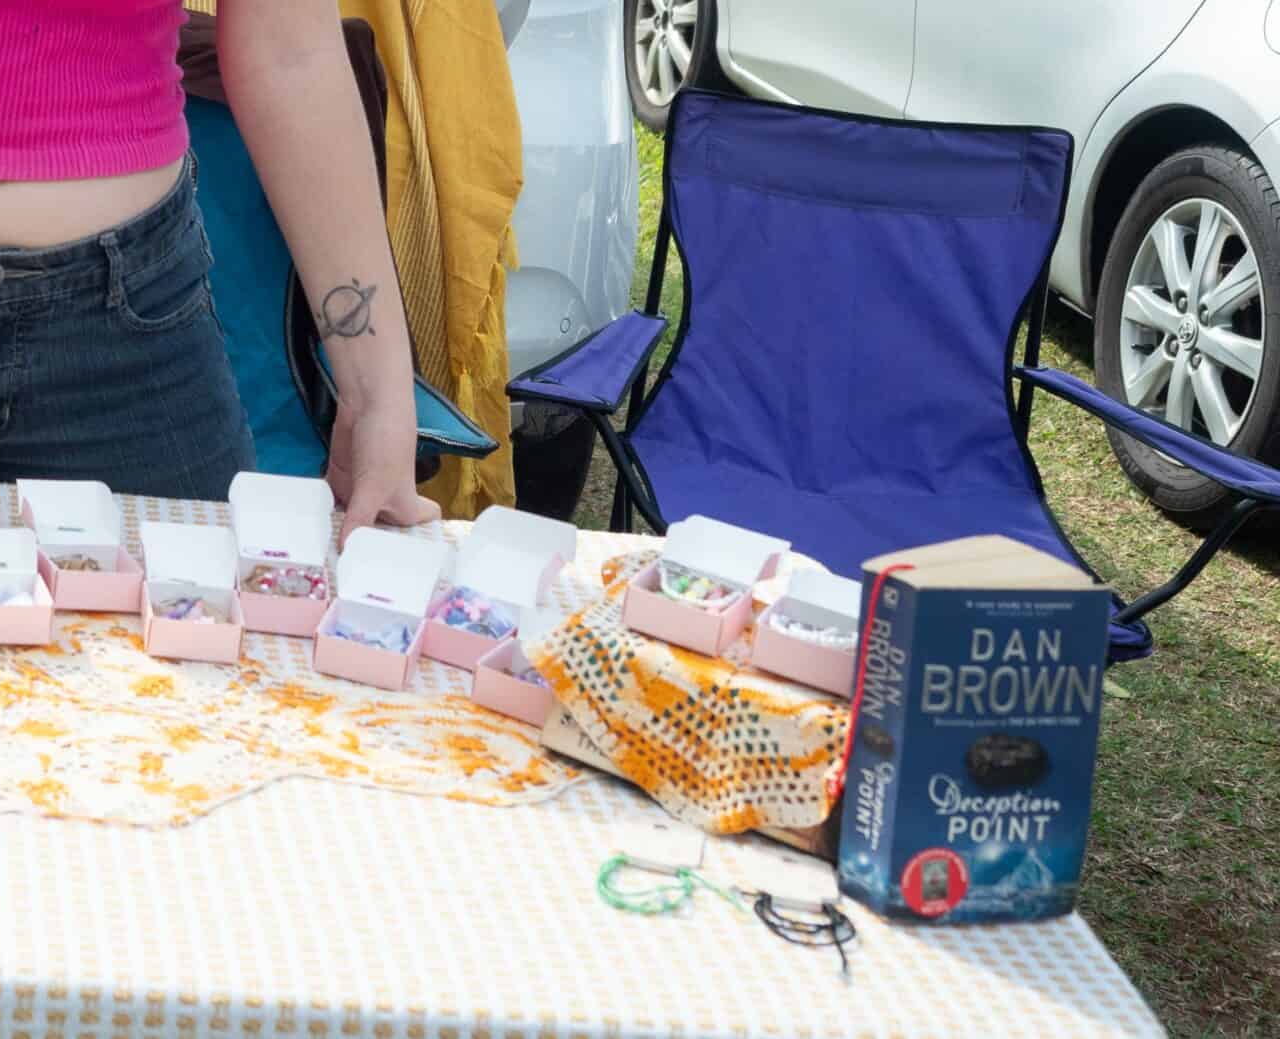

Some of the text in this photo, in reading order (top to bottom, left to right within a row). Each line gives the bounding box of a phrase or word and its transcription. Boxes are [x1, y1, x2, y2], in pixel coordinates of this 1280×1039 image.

[862, 617, 892, 720] BROWN
[970, 627, 1062, 662] DAN
[885, 645, 907, 706] DAN
[921, 663, 1097, 715] BROWN
[855, 767, 877, 841] POINT
[928, 773, 1061, 827] Deception
[947, 815, 1051, 844] POINT
